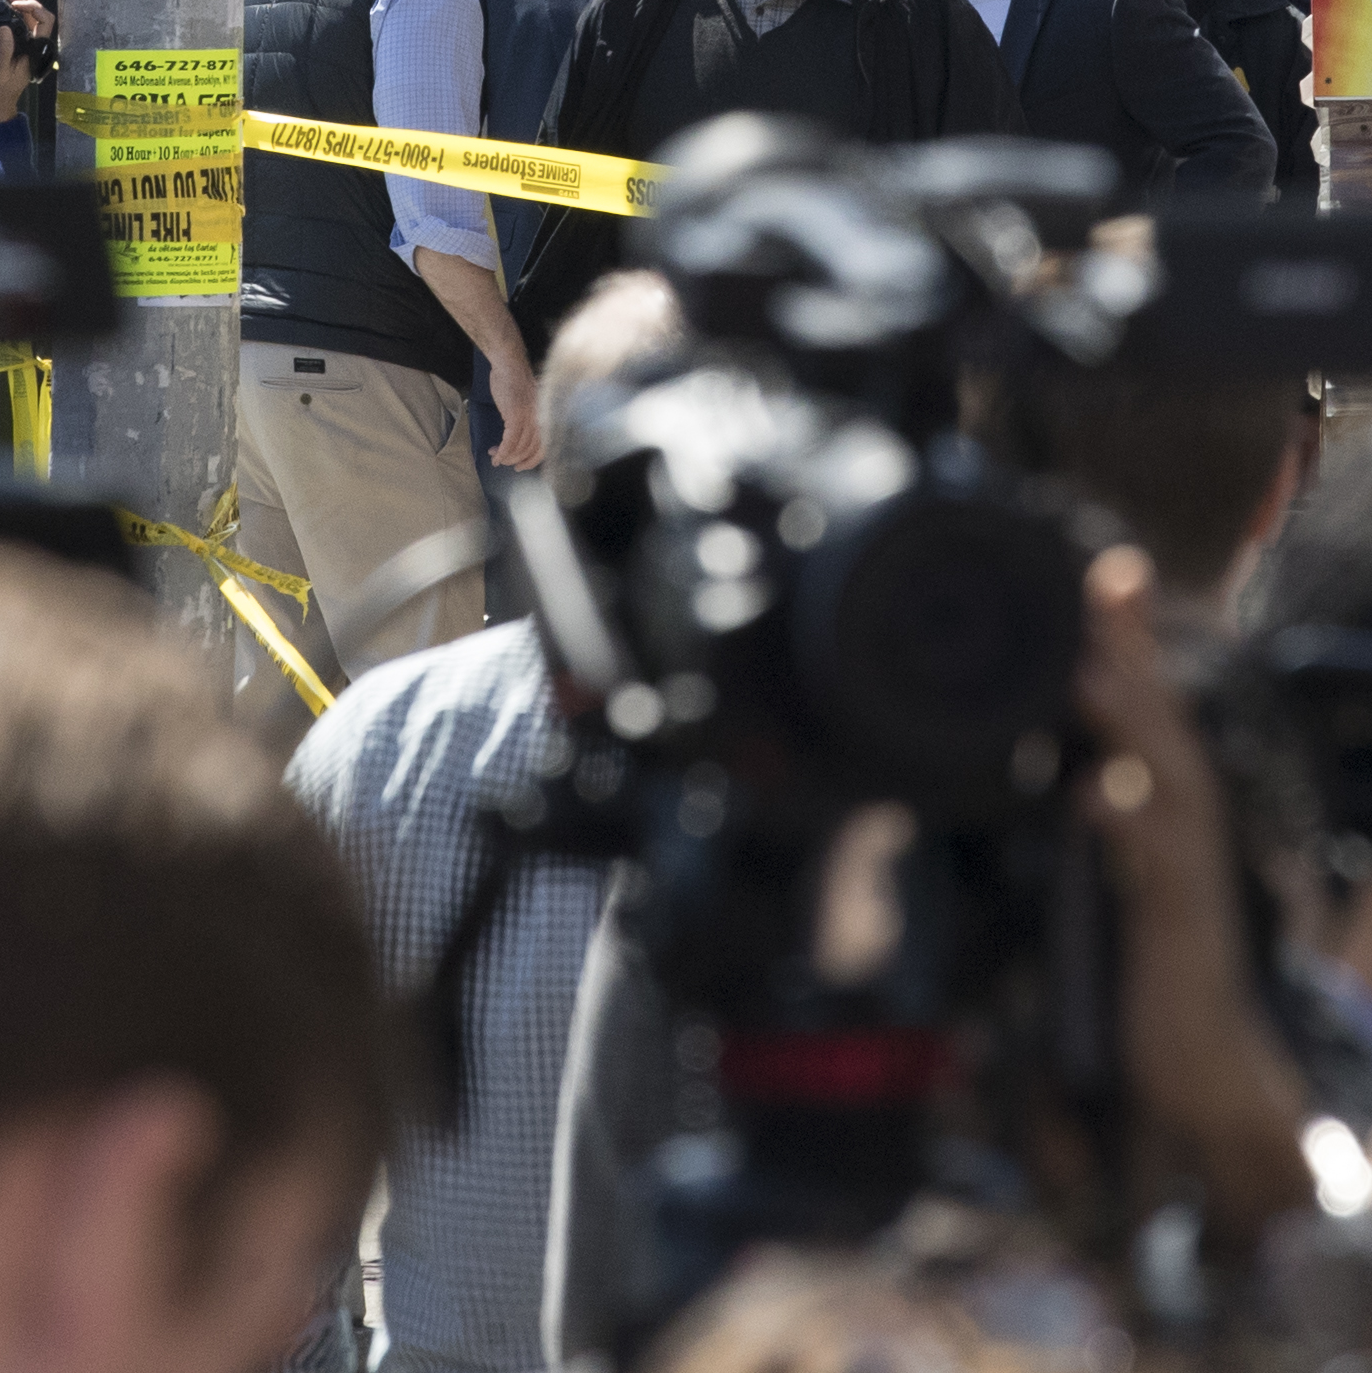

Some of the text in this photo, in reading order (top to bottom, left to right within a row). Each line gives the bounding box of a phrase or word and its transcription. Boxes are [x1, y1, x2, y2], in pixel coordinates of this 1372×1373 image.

[114, 59, 235, 72] 646-727-877
[129, 75, 166, 87] McDonald
[270, 122, 323, 157] (8477)
[110, 146, 124, 161] 30
[324, 129, 446, 173] 1-800-577-TIPS
[625, 177, 657, 207] OSS
